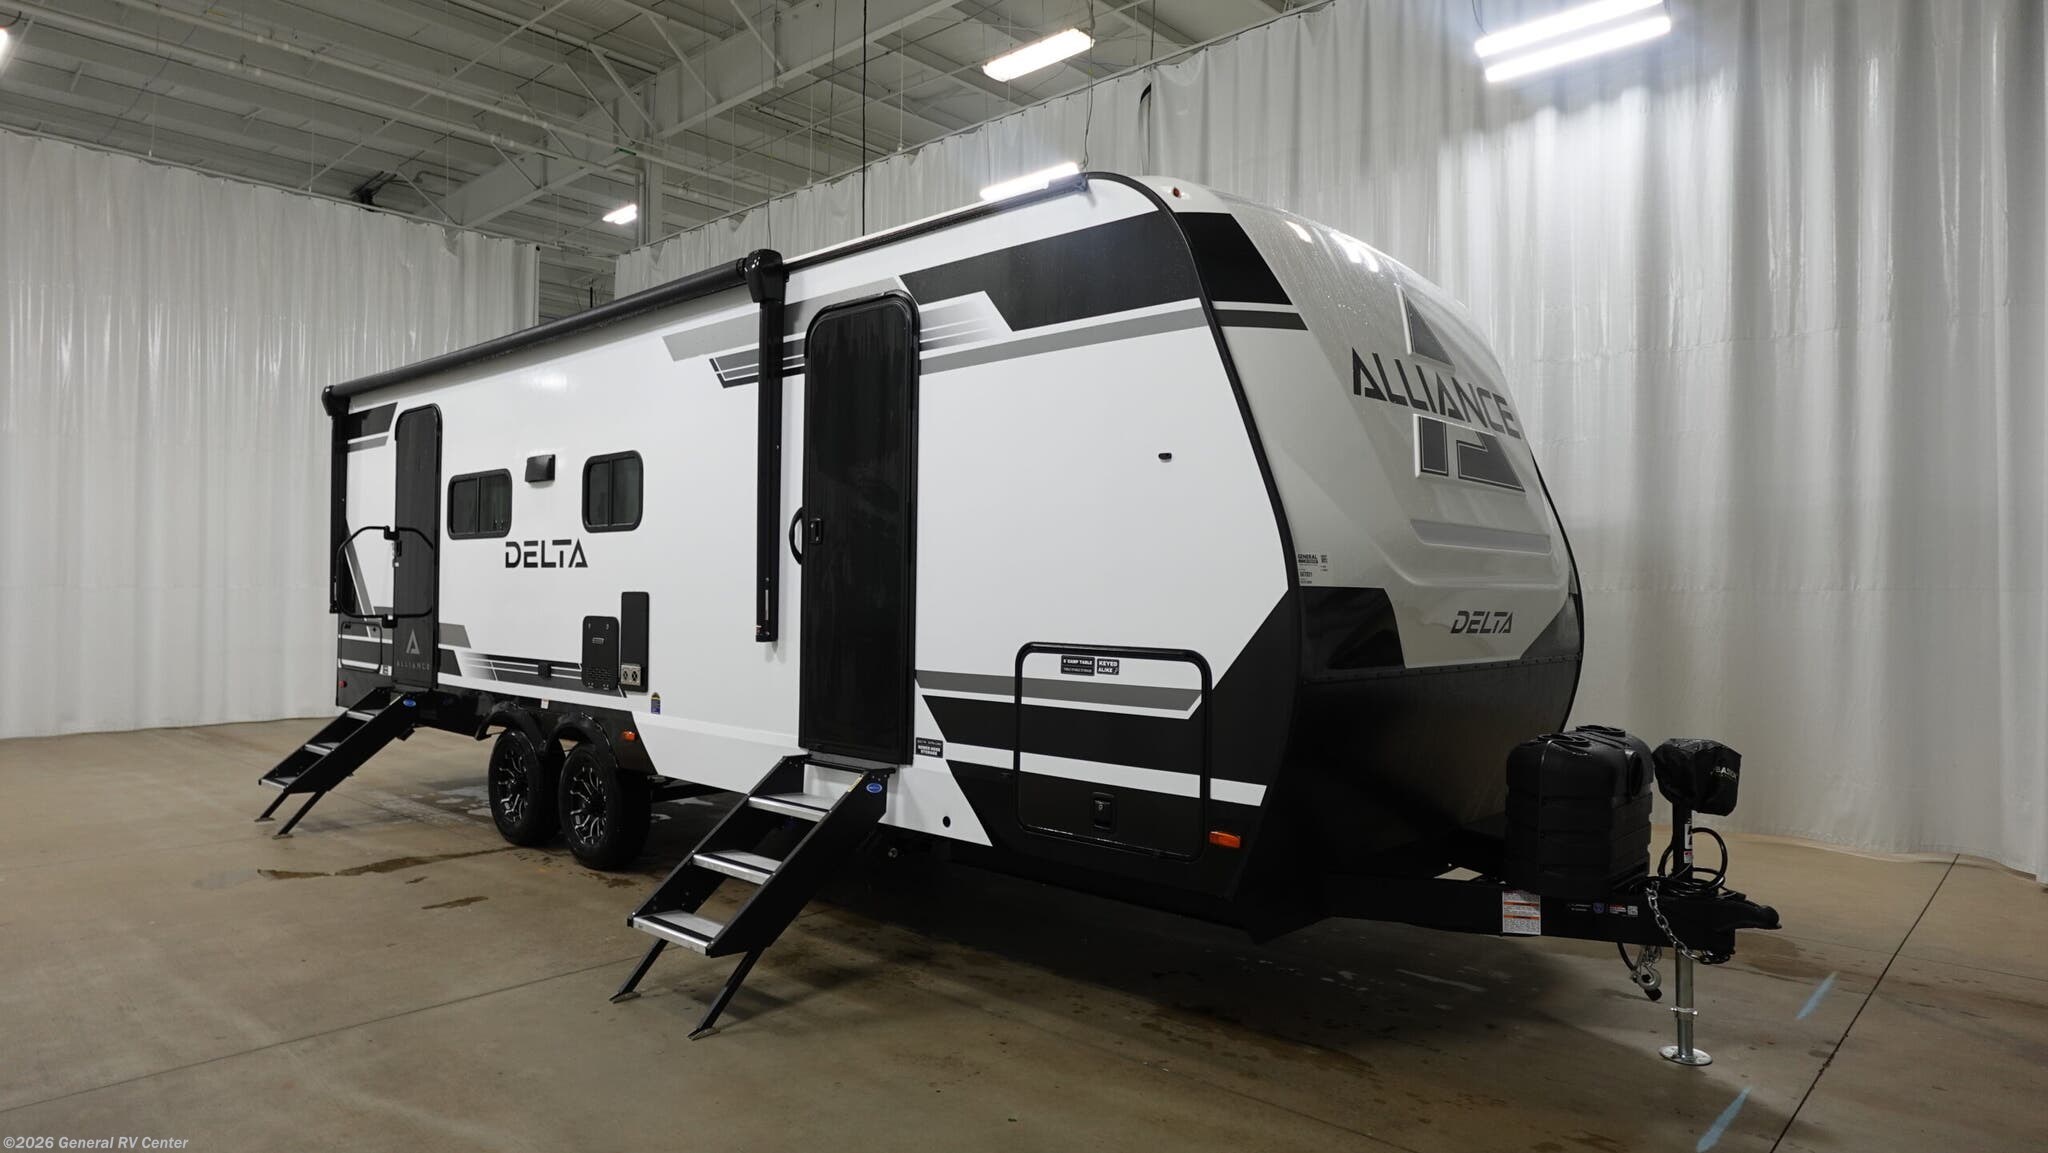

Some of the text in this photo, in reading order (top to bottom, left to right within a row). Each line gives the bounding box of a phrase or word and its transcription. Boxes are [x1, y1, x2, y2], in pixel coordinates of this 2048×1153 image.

[1352, 347, 1521, 440] ALLIANCE
[505, 538, 588, 568] DELTA
[1450, 610, 1513, 634] DELTA
[396, 660, 430, 671] ALLIANCE
